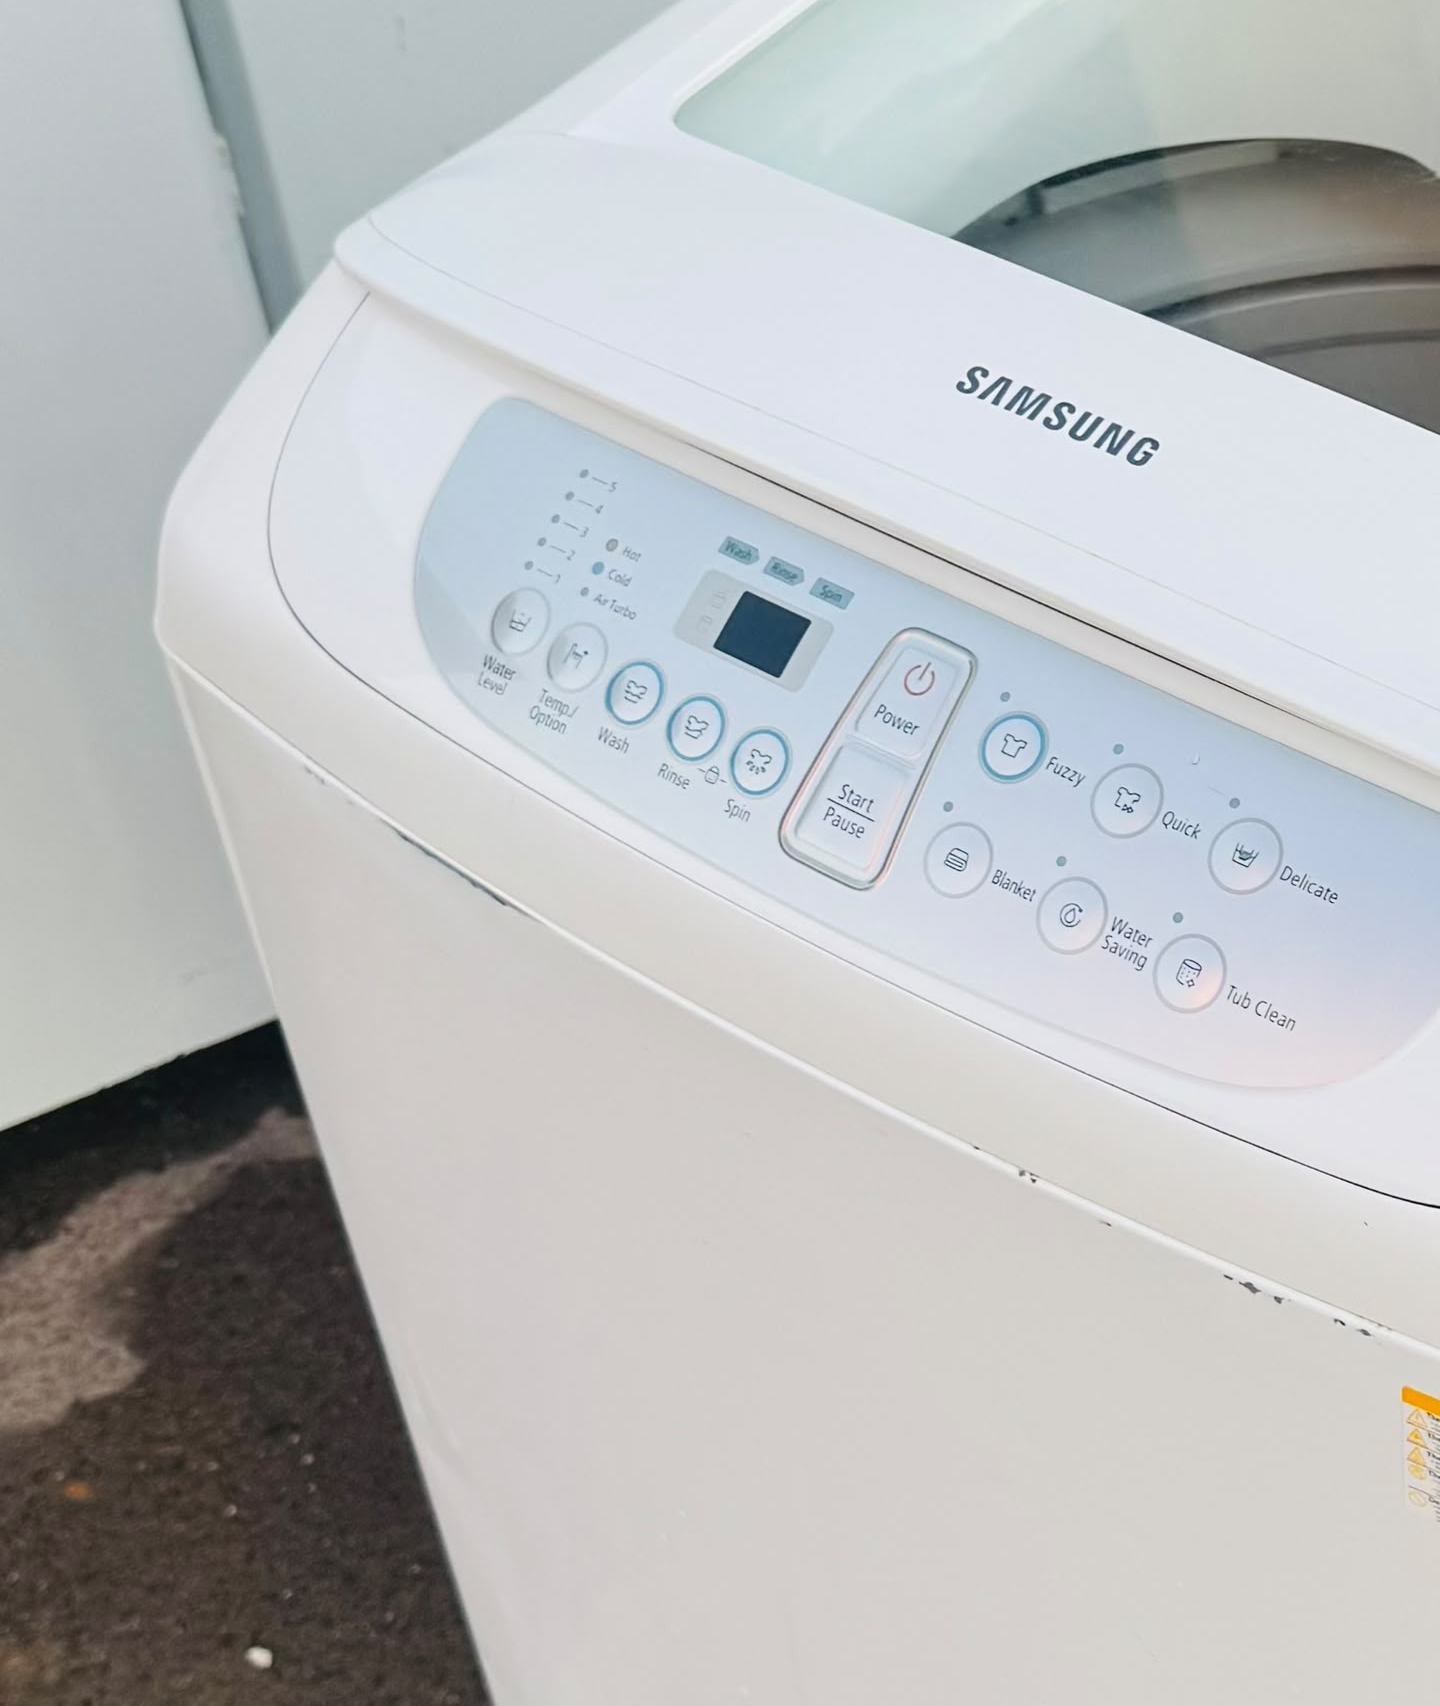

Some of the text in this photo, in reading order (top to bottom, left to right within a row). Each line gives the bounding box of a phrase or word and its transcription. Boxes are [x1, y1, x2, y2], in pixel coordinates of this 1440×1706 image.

[955, 365, 1161, 467] SAMSUNG
[622, 546, 642, 563] Hot
[607, 568, 632, 587] Cold
[482, 654, 517, 681] Water
[477, 672, 508, 696] Level
[529, 705, 567, 735] Option
[873, 703, 921, 738] Power
[597, 726, 630, 754] Wash
[657, 763, 690, 790] Rinse
[1046, 756, 1086, 788] Fuzzy
[724, 798, 751, 823] Spin
[837, 782, 876, 815] Start
[823, 806, 866, 840] Pause
[1161, 810, 1202, 841] Quick
[991, 868, 1037, 904] Blanket
[1279, 865, 1340, 905] Delicate
[1110, 916, 1153, 949] Water
[1100, 934, 1149, 972] Saving
[1225, 984, 1298, 1033] Tub Clean
